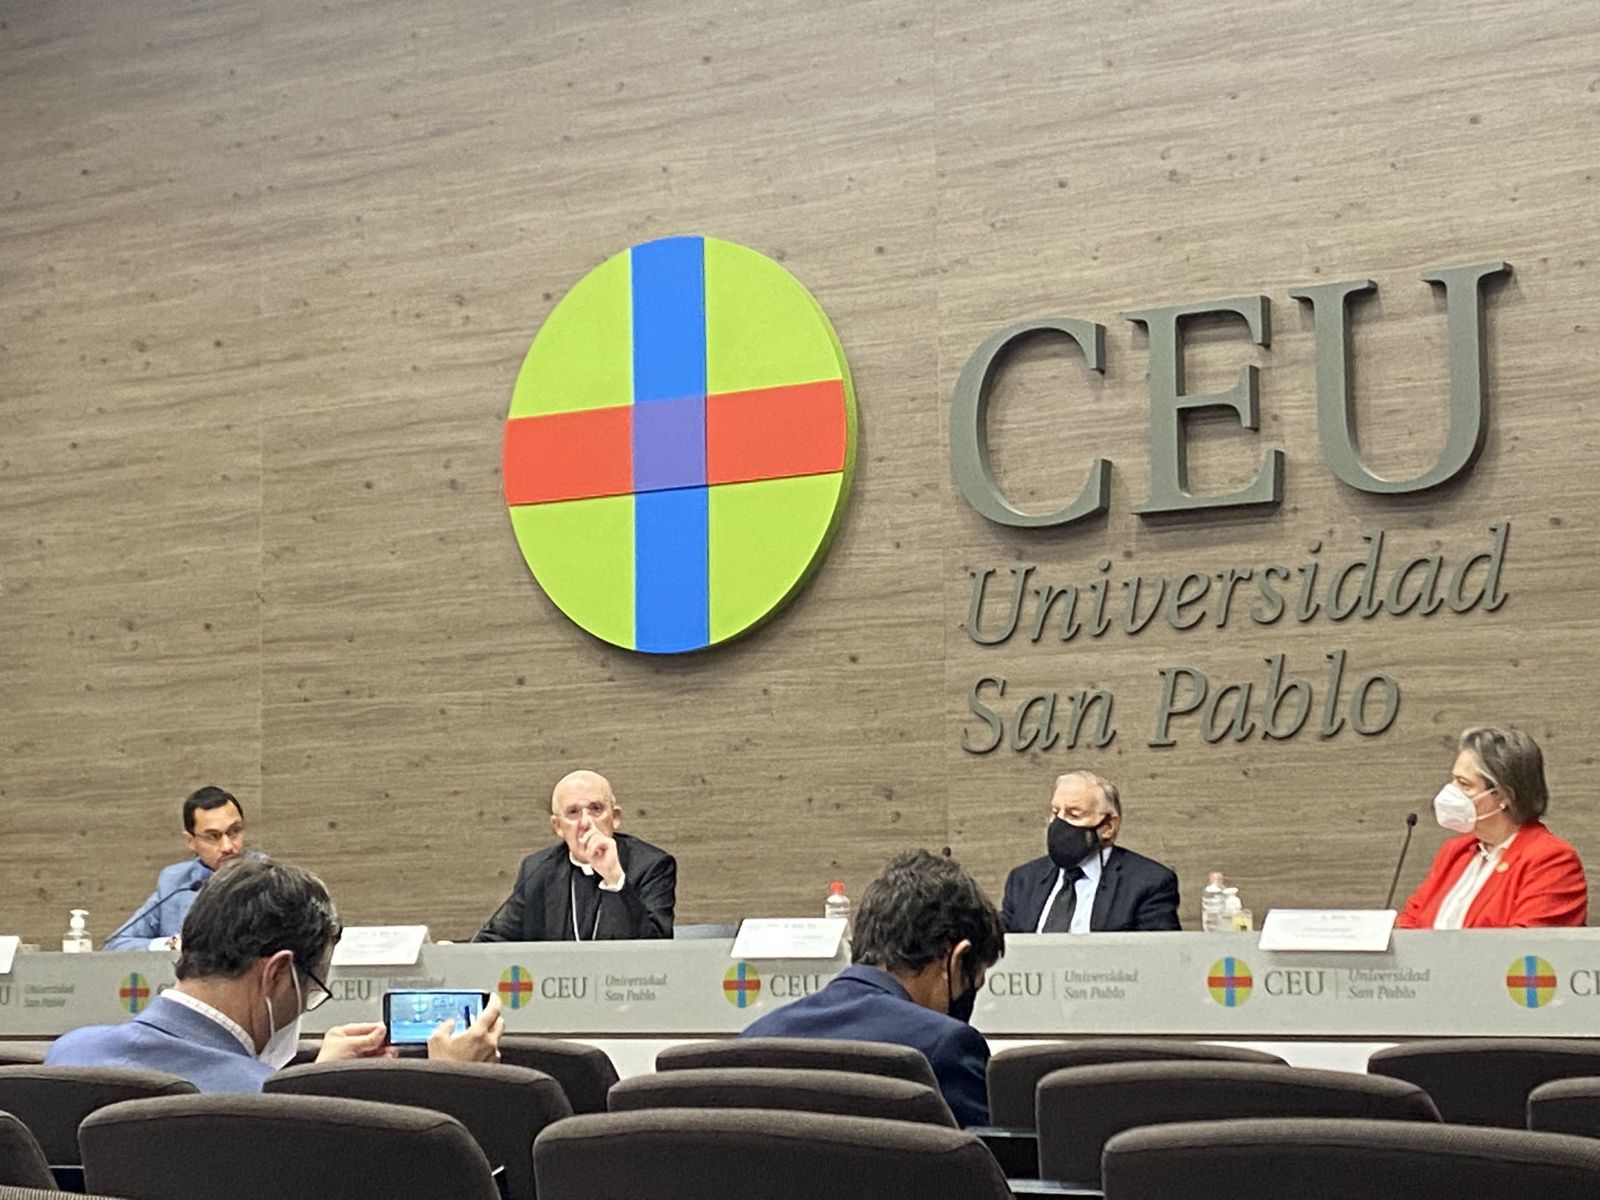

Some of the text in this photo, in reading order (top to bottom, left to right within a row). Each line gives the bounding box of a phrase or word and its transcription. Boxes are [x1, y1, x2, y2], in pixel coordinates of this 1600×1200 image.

[949, 262, 1513, 527] CEU
[963, 522, 1511, 645] Universidad
[961, 649, 1402, 755] San Pablo
[605, 974, 667, 986] Universidad
[770, 974, 820, 997] CEU
[988, 972, 1043, 996] CEU
[1064, 970, 1138, 983] Universidad
[1264, 970, 1325, 996] CEU
[1348, 968, 1430, 983] Universidad
[329, 979, 372, 1000] CEU
[541, 977, 589, 999] CEU
[1064, 984, 1125, 999] San Pablo
[1348, 985, 1416, 1000] San Pablo
